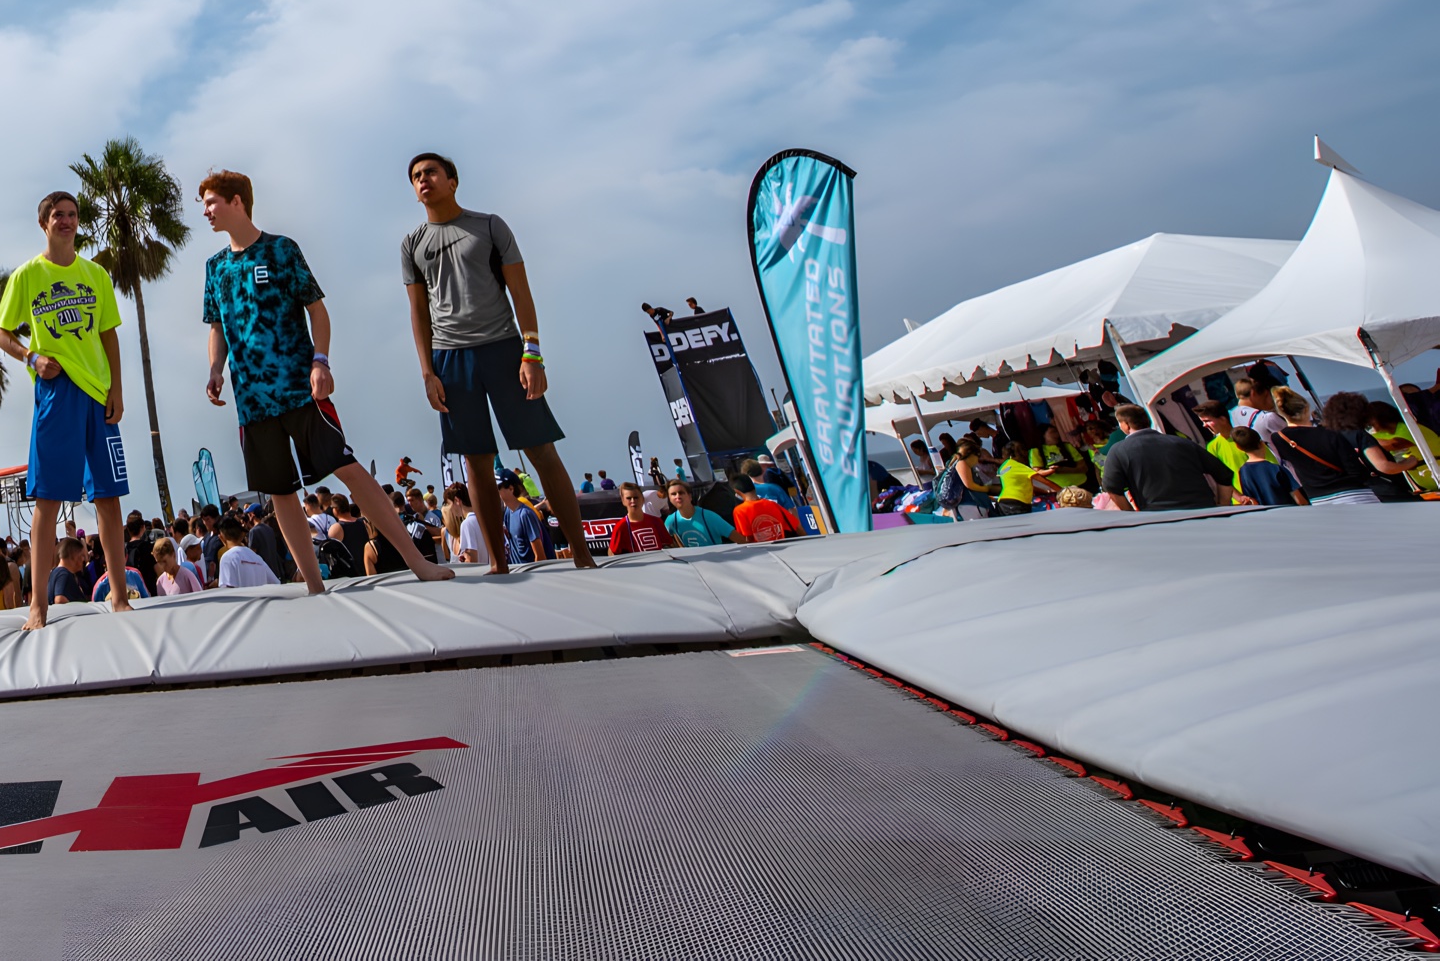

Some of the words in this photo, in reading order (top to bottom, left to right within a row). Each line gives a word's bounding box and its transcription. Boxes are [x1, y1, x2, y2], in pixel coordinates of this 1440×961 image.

[804, 257, 835, 466] GRAVITATED
[826, 264, 859, 479] EQUATIONS
[198, 762, 446, 849] AIR
